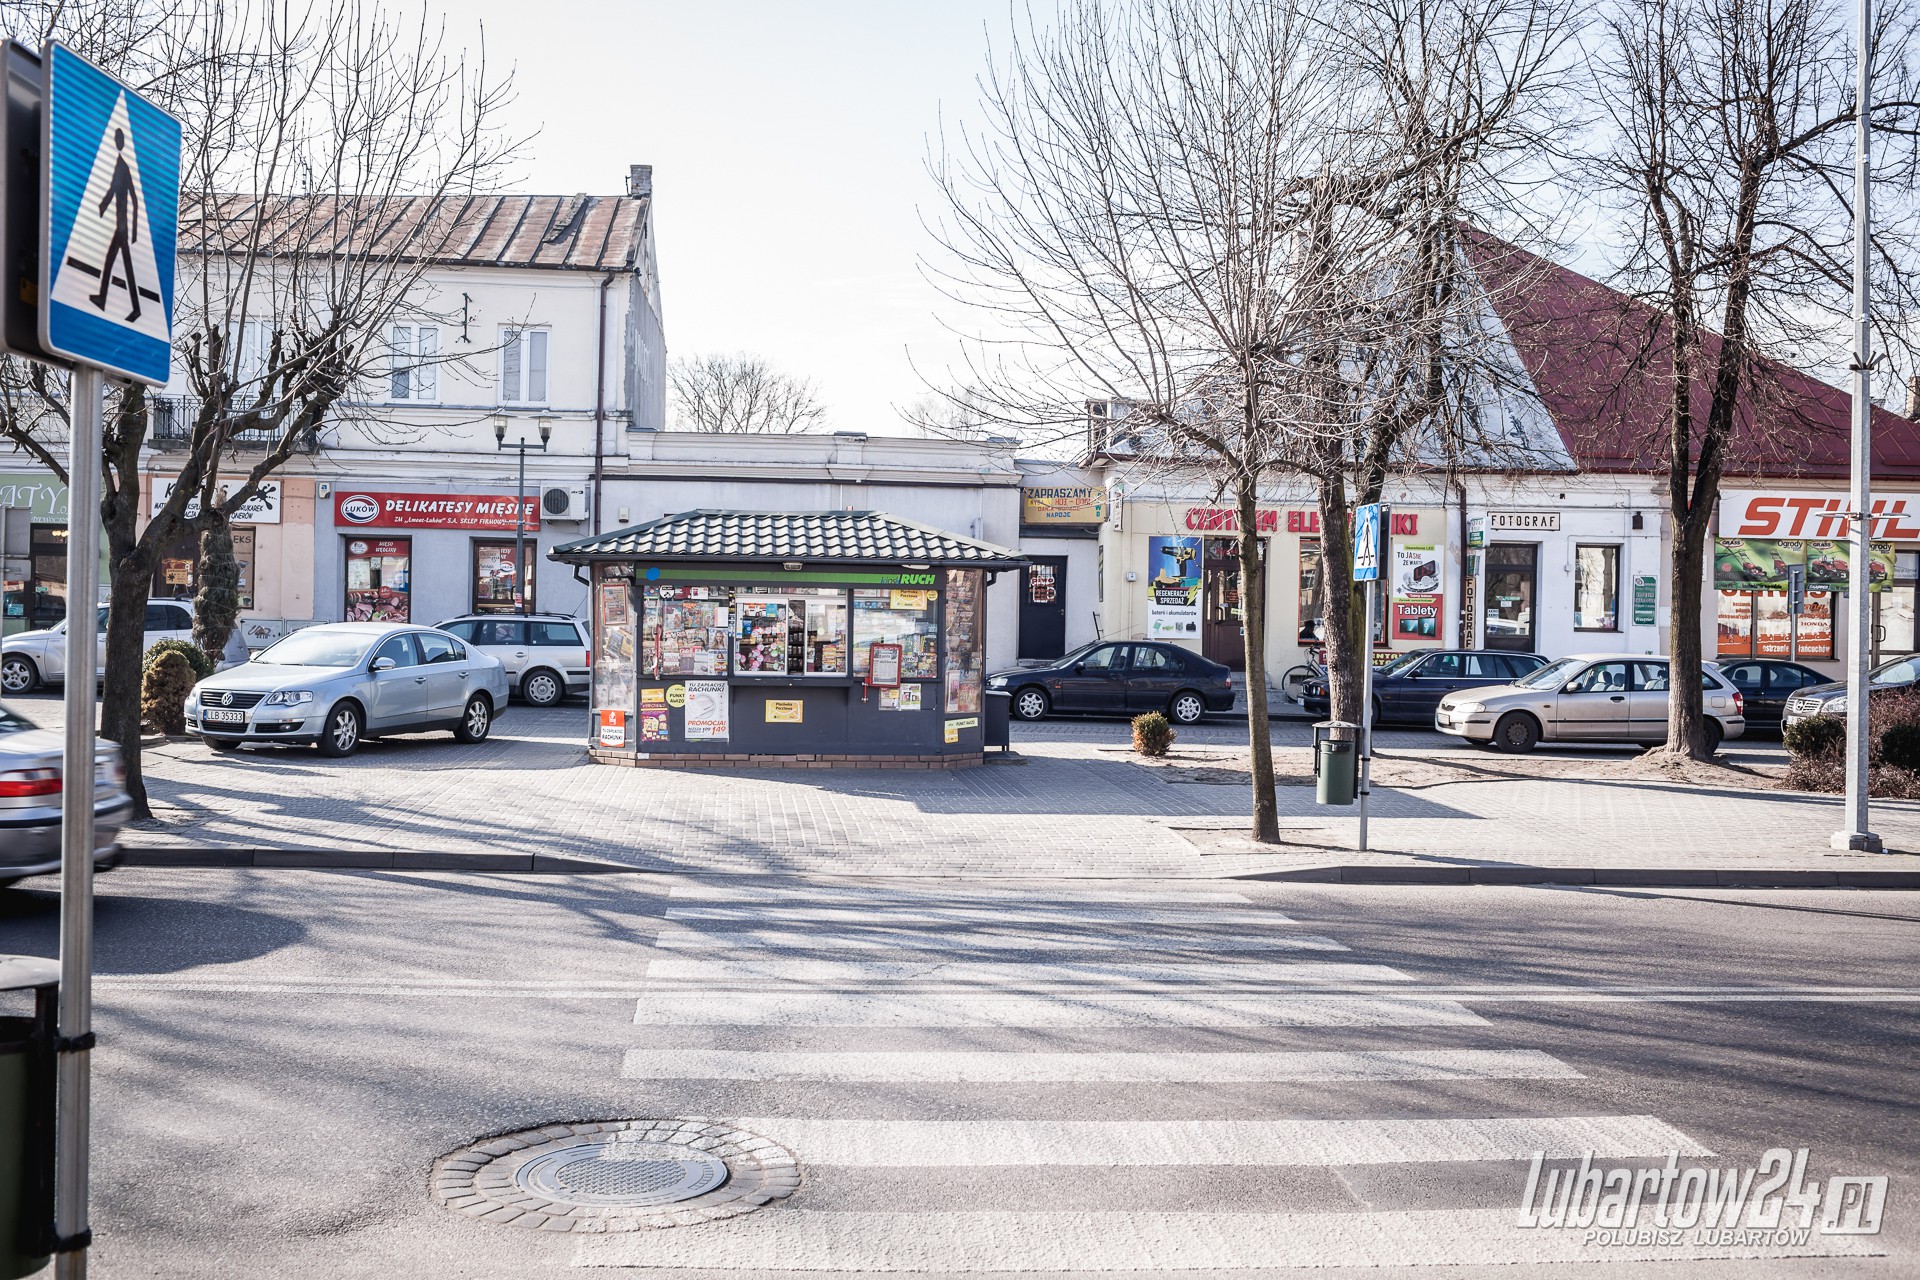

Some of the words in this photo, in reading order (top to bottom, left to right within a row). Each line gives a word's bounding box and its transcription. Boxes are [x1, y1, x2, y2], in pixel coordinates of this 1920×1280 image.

[1027, 488, 1093, 499] ZAPRASZAMY
[344, 504, 376, 513] ŁUKÓW
[385, 499, 473, 513] DELIKATESY
[230, 512, 254, 520] ONERÓW
[1491, 514, 1556, 527] FOTOGRAF
[233, 535, 252, 544] EKS
[1777, 540, 1804, 548] Ogrody
[1868, 542, 1892, 552] grody
[1397, 551, 1405, 559] TO
[1405, 551, 1422, 560] JASNE
[900, 573, 936, 585] RUCH
[1155, 589, 1190, 597] REGENERACJA
[1397, 604, 1438, 618] Tablety
[1465, 579, 1473, 648] FOTOGRAF
[1762, 644, 1789, 652] ostrzenie
[221, 711, 243, 721] 35333
